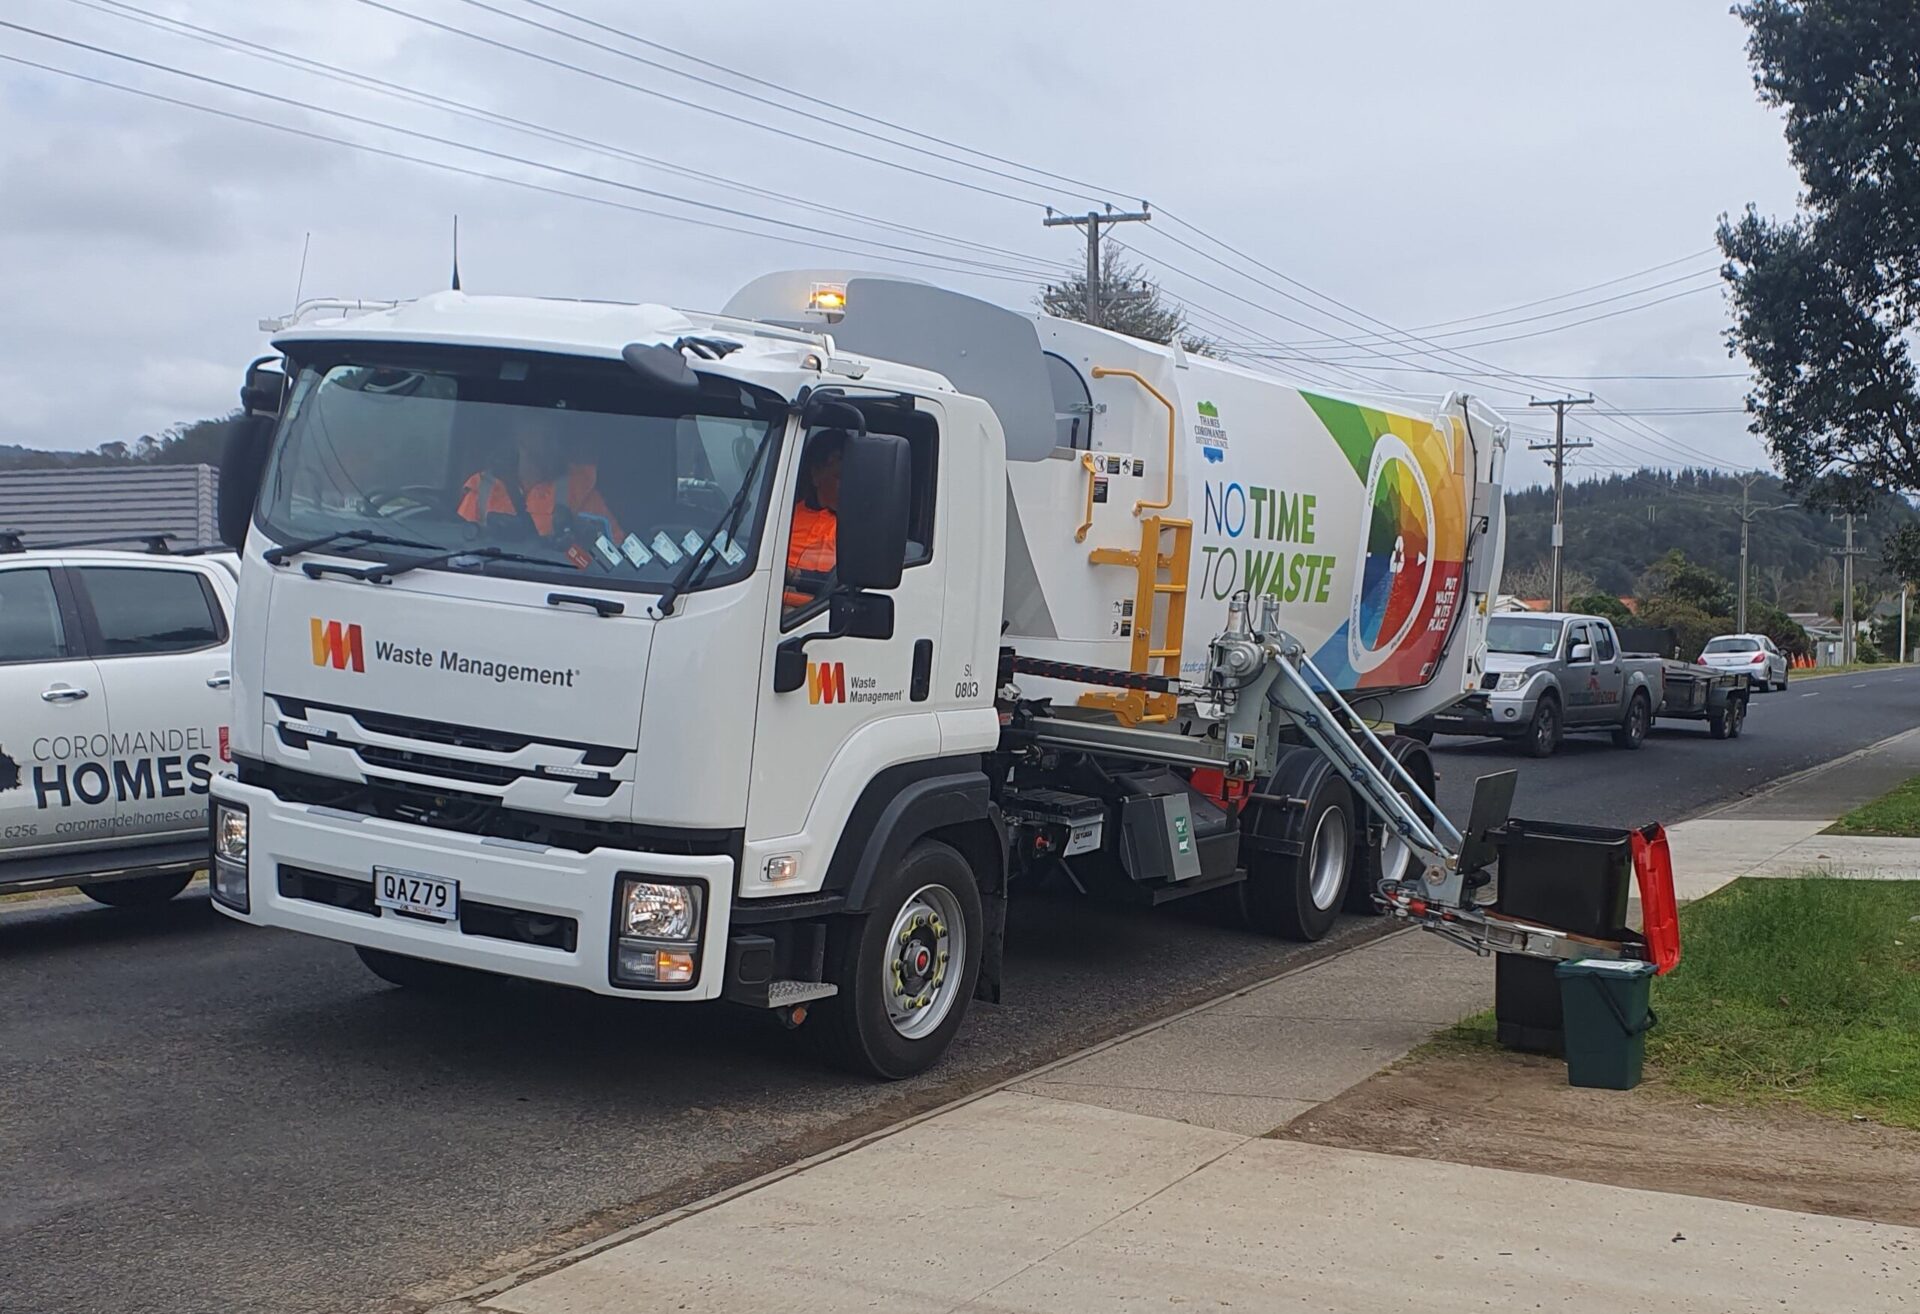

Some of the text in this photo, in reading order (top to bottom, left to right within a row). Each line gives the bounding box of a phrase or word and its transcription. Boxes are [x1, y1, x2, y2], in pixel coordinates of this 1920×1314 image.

[1204, 480, 1316, 544] NO TIME
[1200, 546, 1336, 602] TO WASTE
[1444, 577, 1458, 591] PUT
[1435, 591, 1456, 604] WASTE
[1427, 618, 1448, 631] PLACE
[375, 640, 574, 687] Waste Management
[851, 676, 876, 689] Waste
[955, 682, 979, 698] 0803
[849, 690, 902, 704] Management
[33, 728, 212, 761] COROMANDEL
[33, 753, 211, 809] HOMES
[4, 824, 38, 838] 6256
[384, 875, 447, 907] QAZ79
